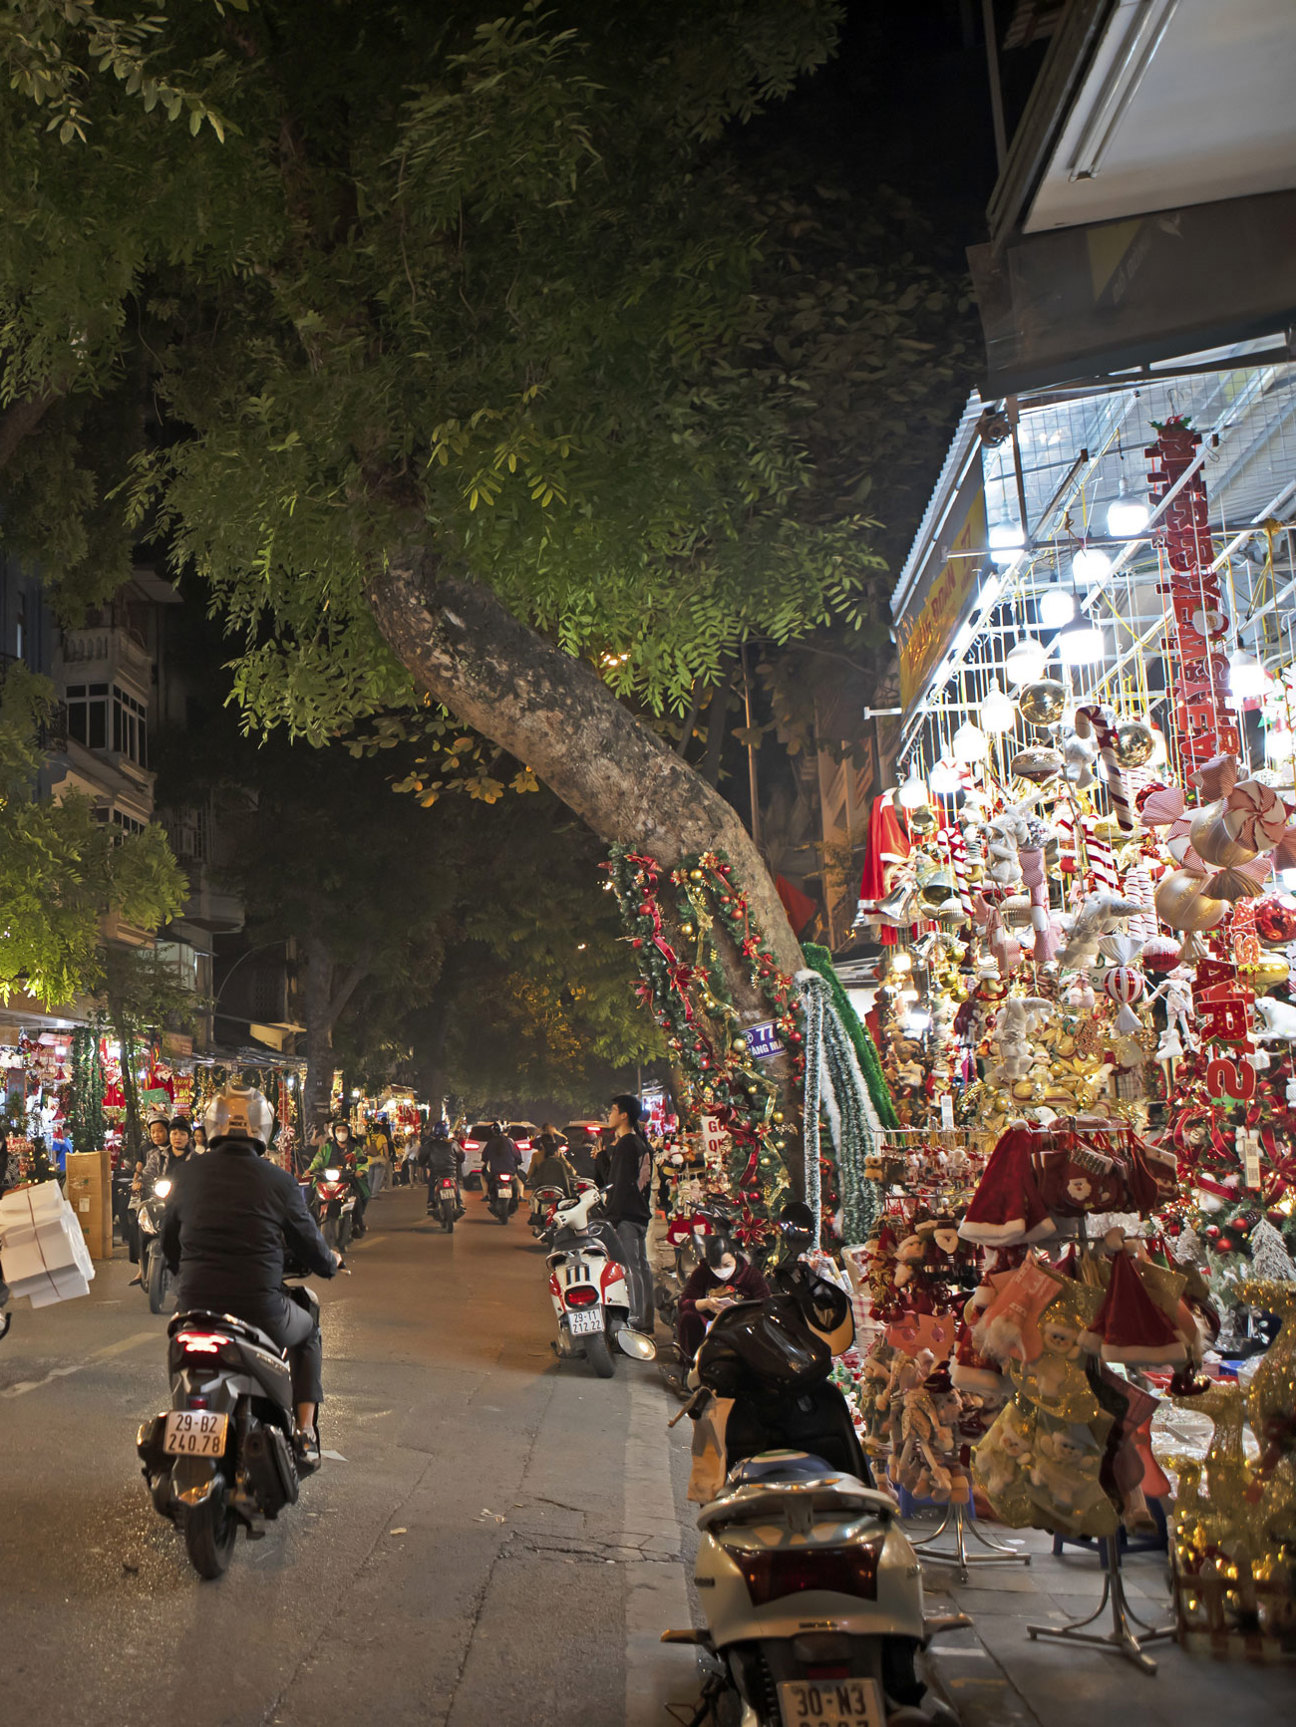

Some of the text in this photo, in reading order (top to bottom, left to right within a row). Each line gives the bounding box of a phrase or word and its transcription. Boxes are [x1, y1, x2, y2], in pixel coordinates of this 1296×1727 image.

[756, 1025, 773, 1041] 77
[574, 1311, 597, 1323] 29-T1
[176, 1414, 217, 1432] 29-B2
[168, 1434, 221, 1453] 240.78
[797, 1685, 867, 1716] 30-N3
